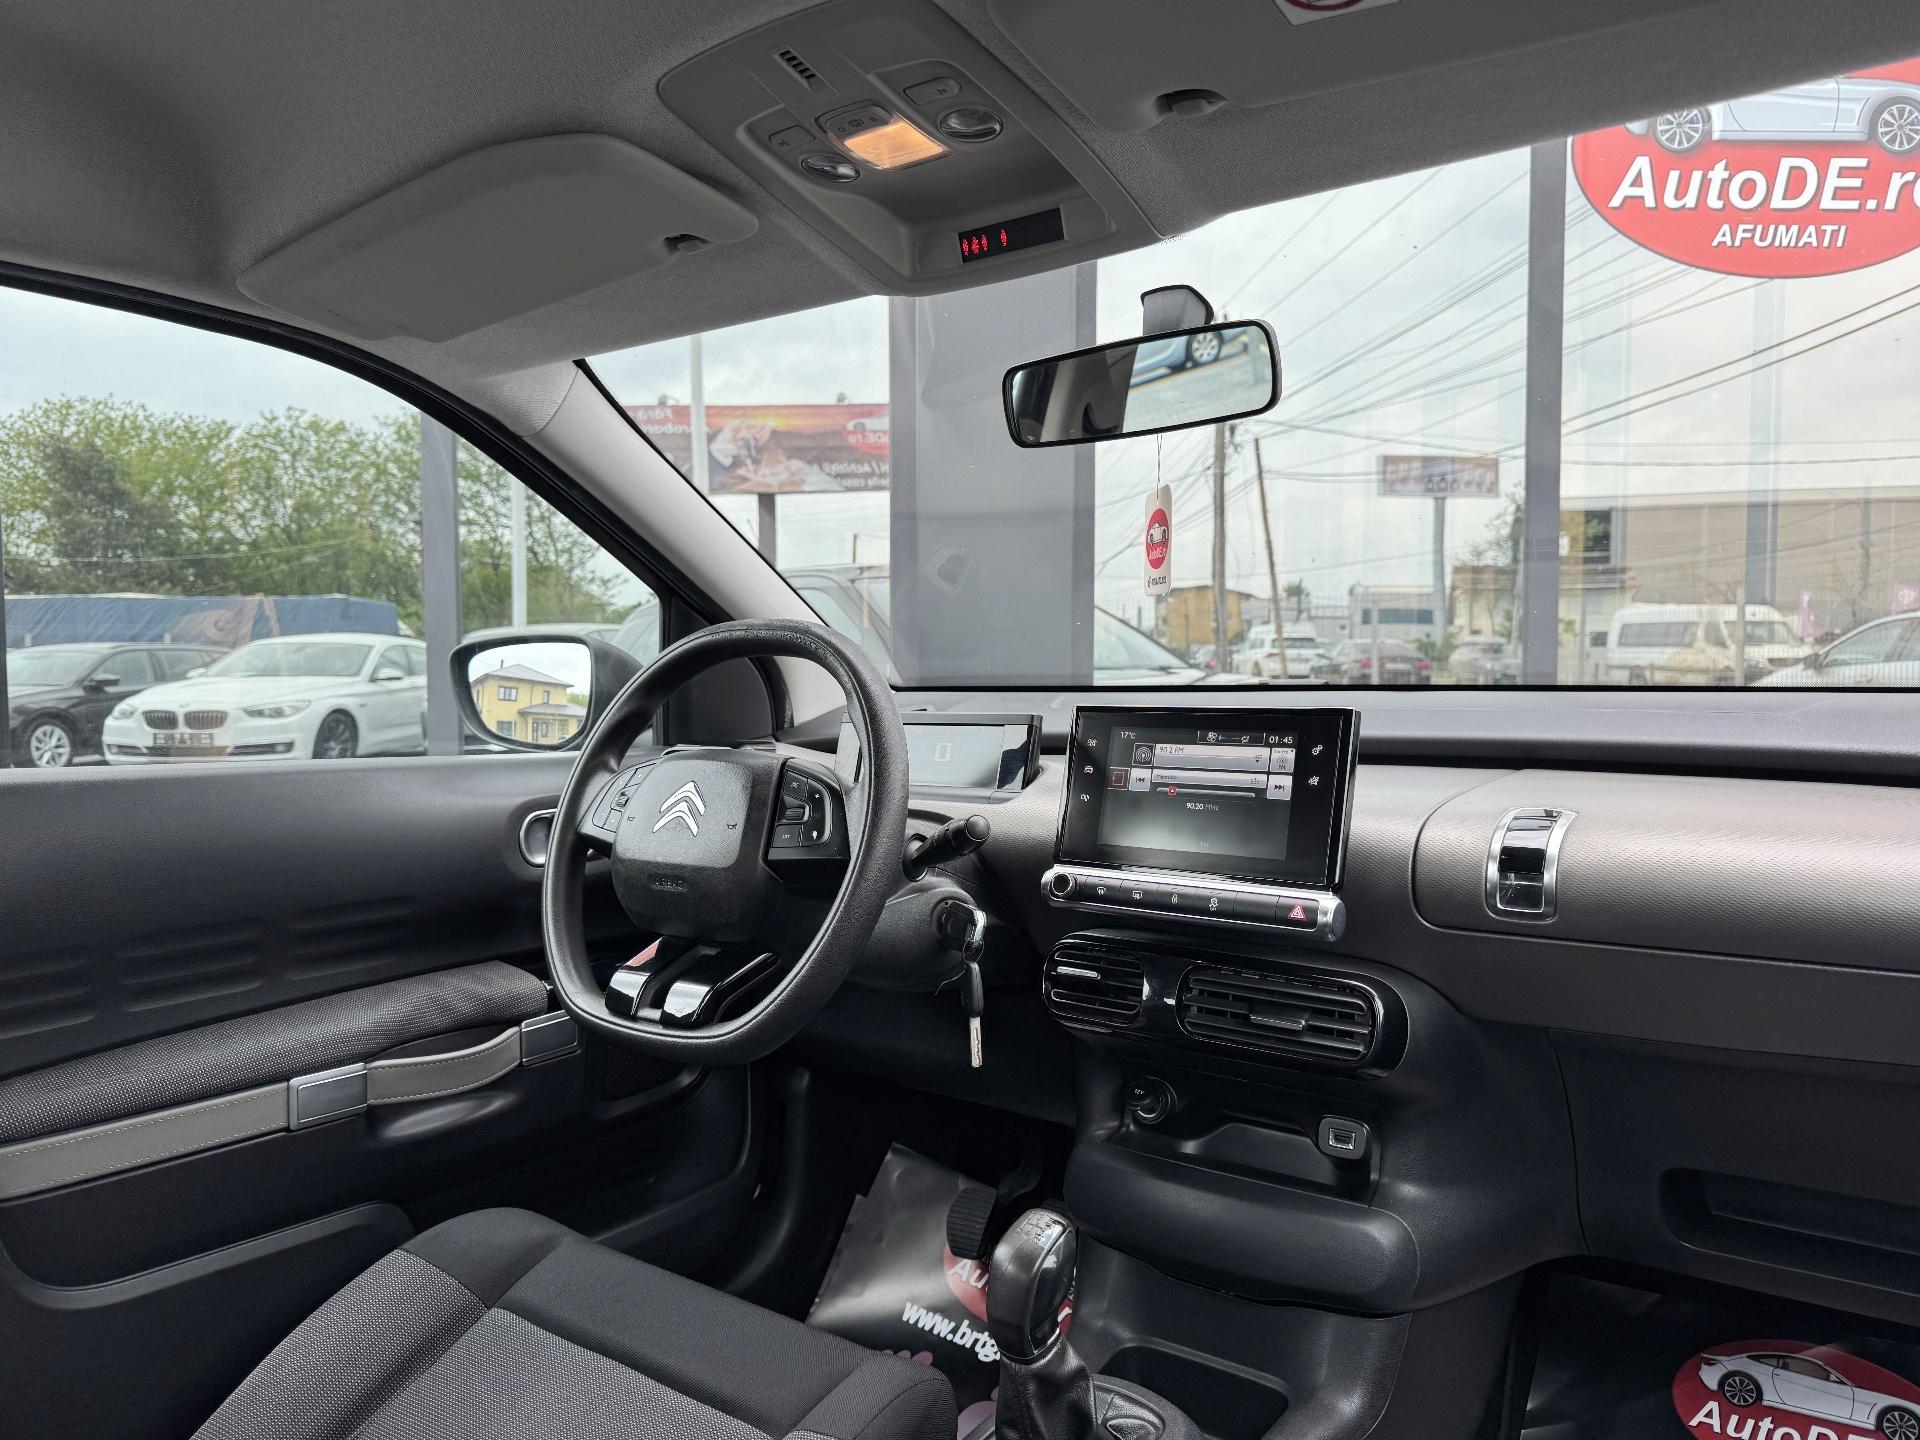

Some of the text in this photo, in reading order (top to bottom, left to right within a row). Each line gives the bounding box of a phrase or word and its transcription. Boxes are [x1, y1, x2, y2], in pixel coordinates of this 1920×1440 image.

[1608, 154, 1920, 210] AutoDE.r
[1711, 223, 1848, 248] AFUMATI
[1269, 736, 1293, 744] 01:45
[1186, 802, 1204, 810] 90.20
